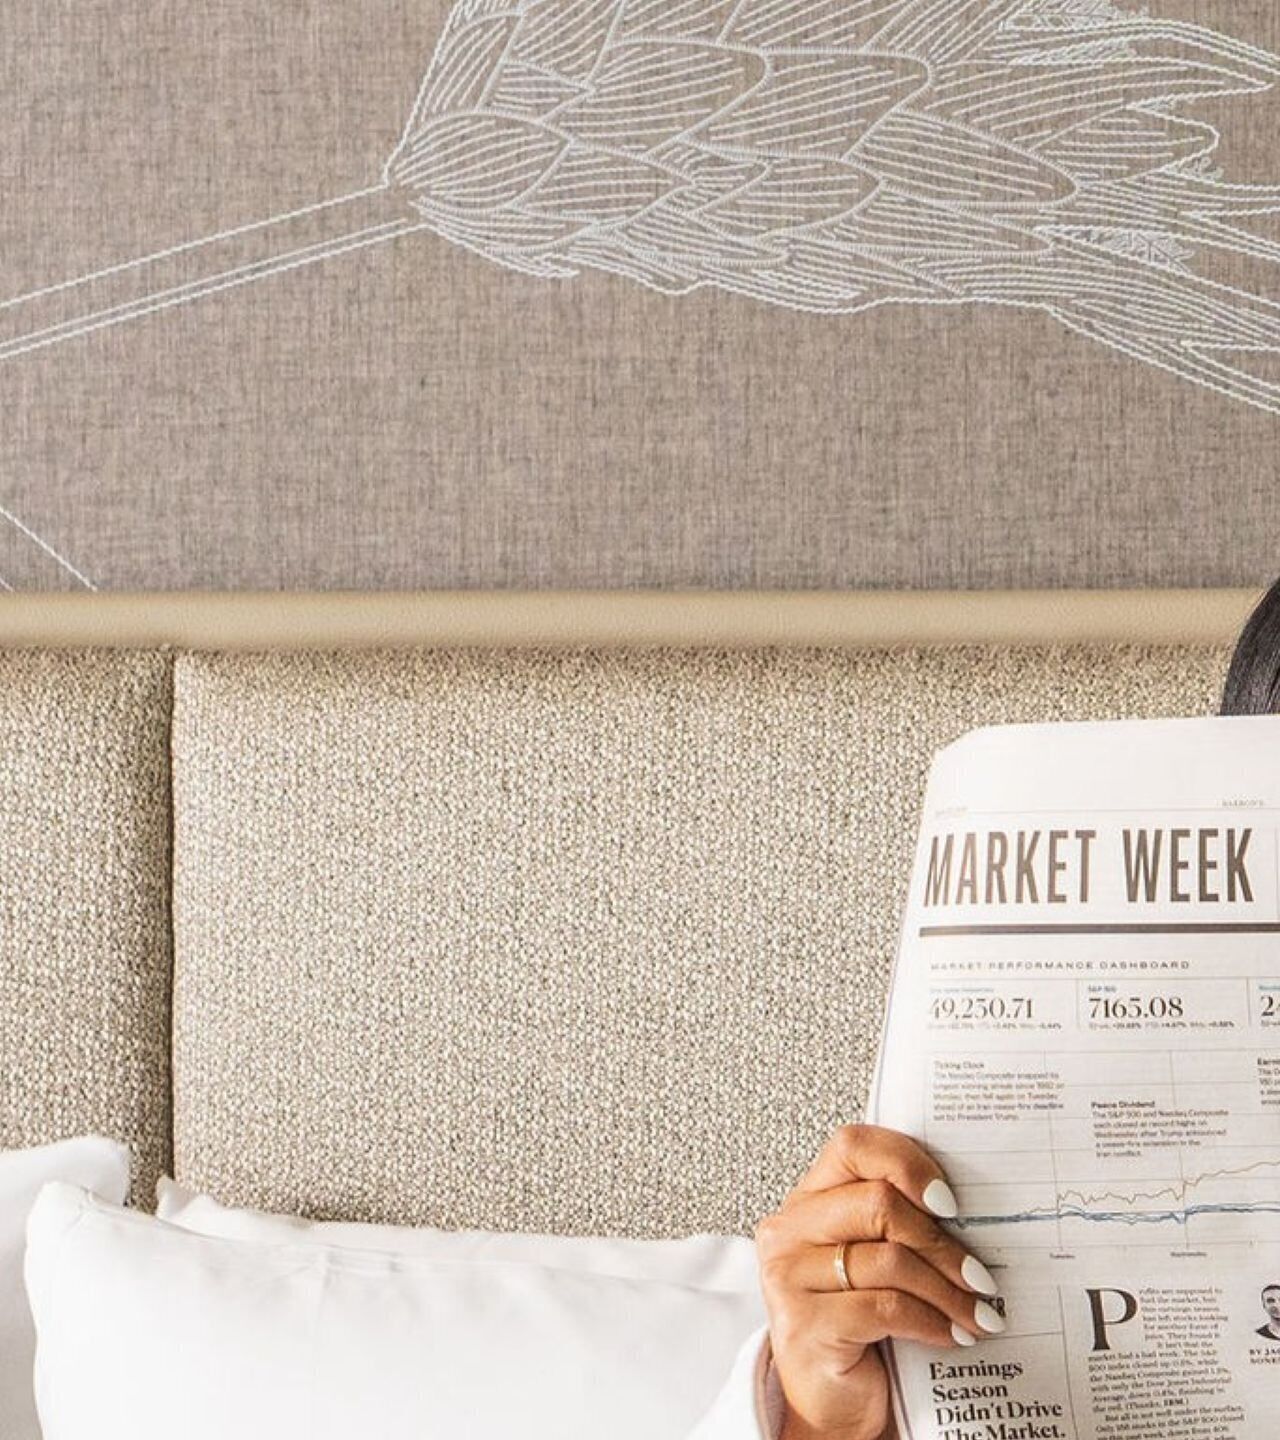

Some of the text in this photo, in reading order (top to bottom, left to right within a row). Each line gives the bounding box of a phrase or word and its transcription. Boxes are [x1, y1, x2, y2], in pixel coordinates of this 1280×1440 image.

[924, 827, 1255, 907] MARKET WEEK
[931, 960, 1190, 971] MARKET PERFORMANCE DASHBOARD
[1089, 996, 1184, 1019] 7165.08
[1085, 1288, 1138, 1351] P
[929, 1360, 1024, 1381] Earnings
[932, 1384, 1009, 1403] Season
[936, 1400, 1064, 1426] Didn't Drive
